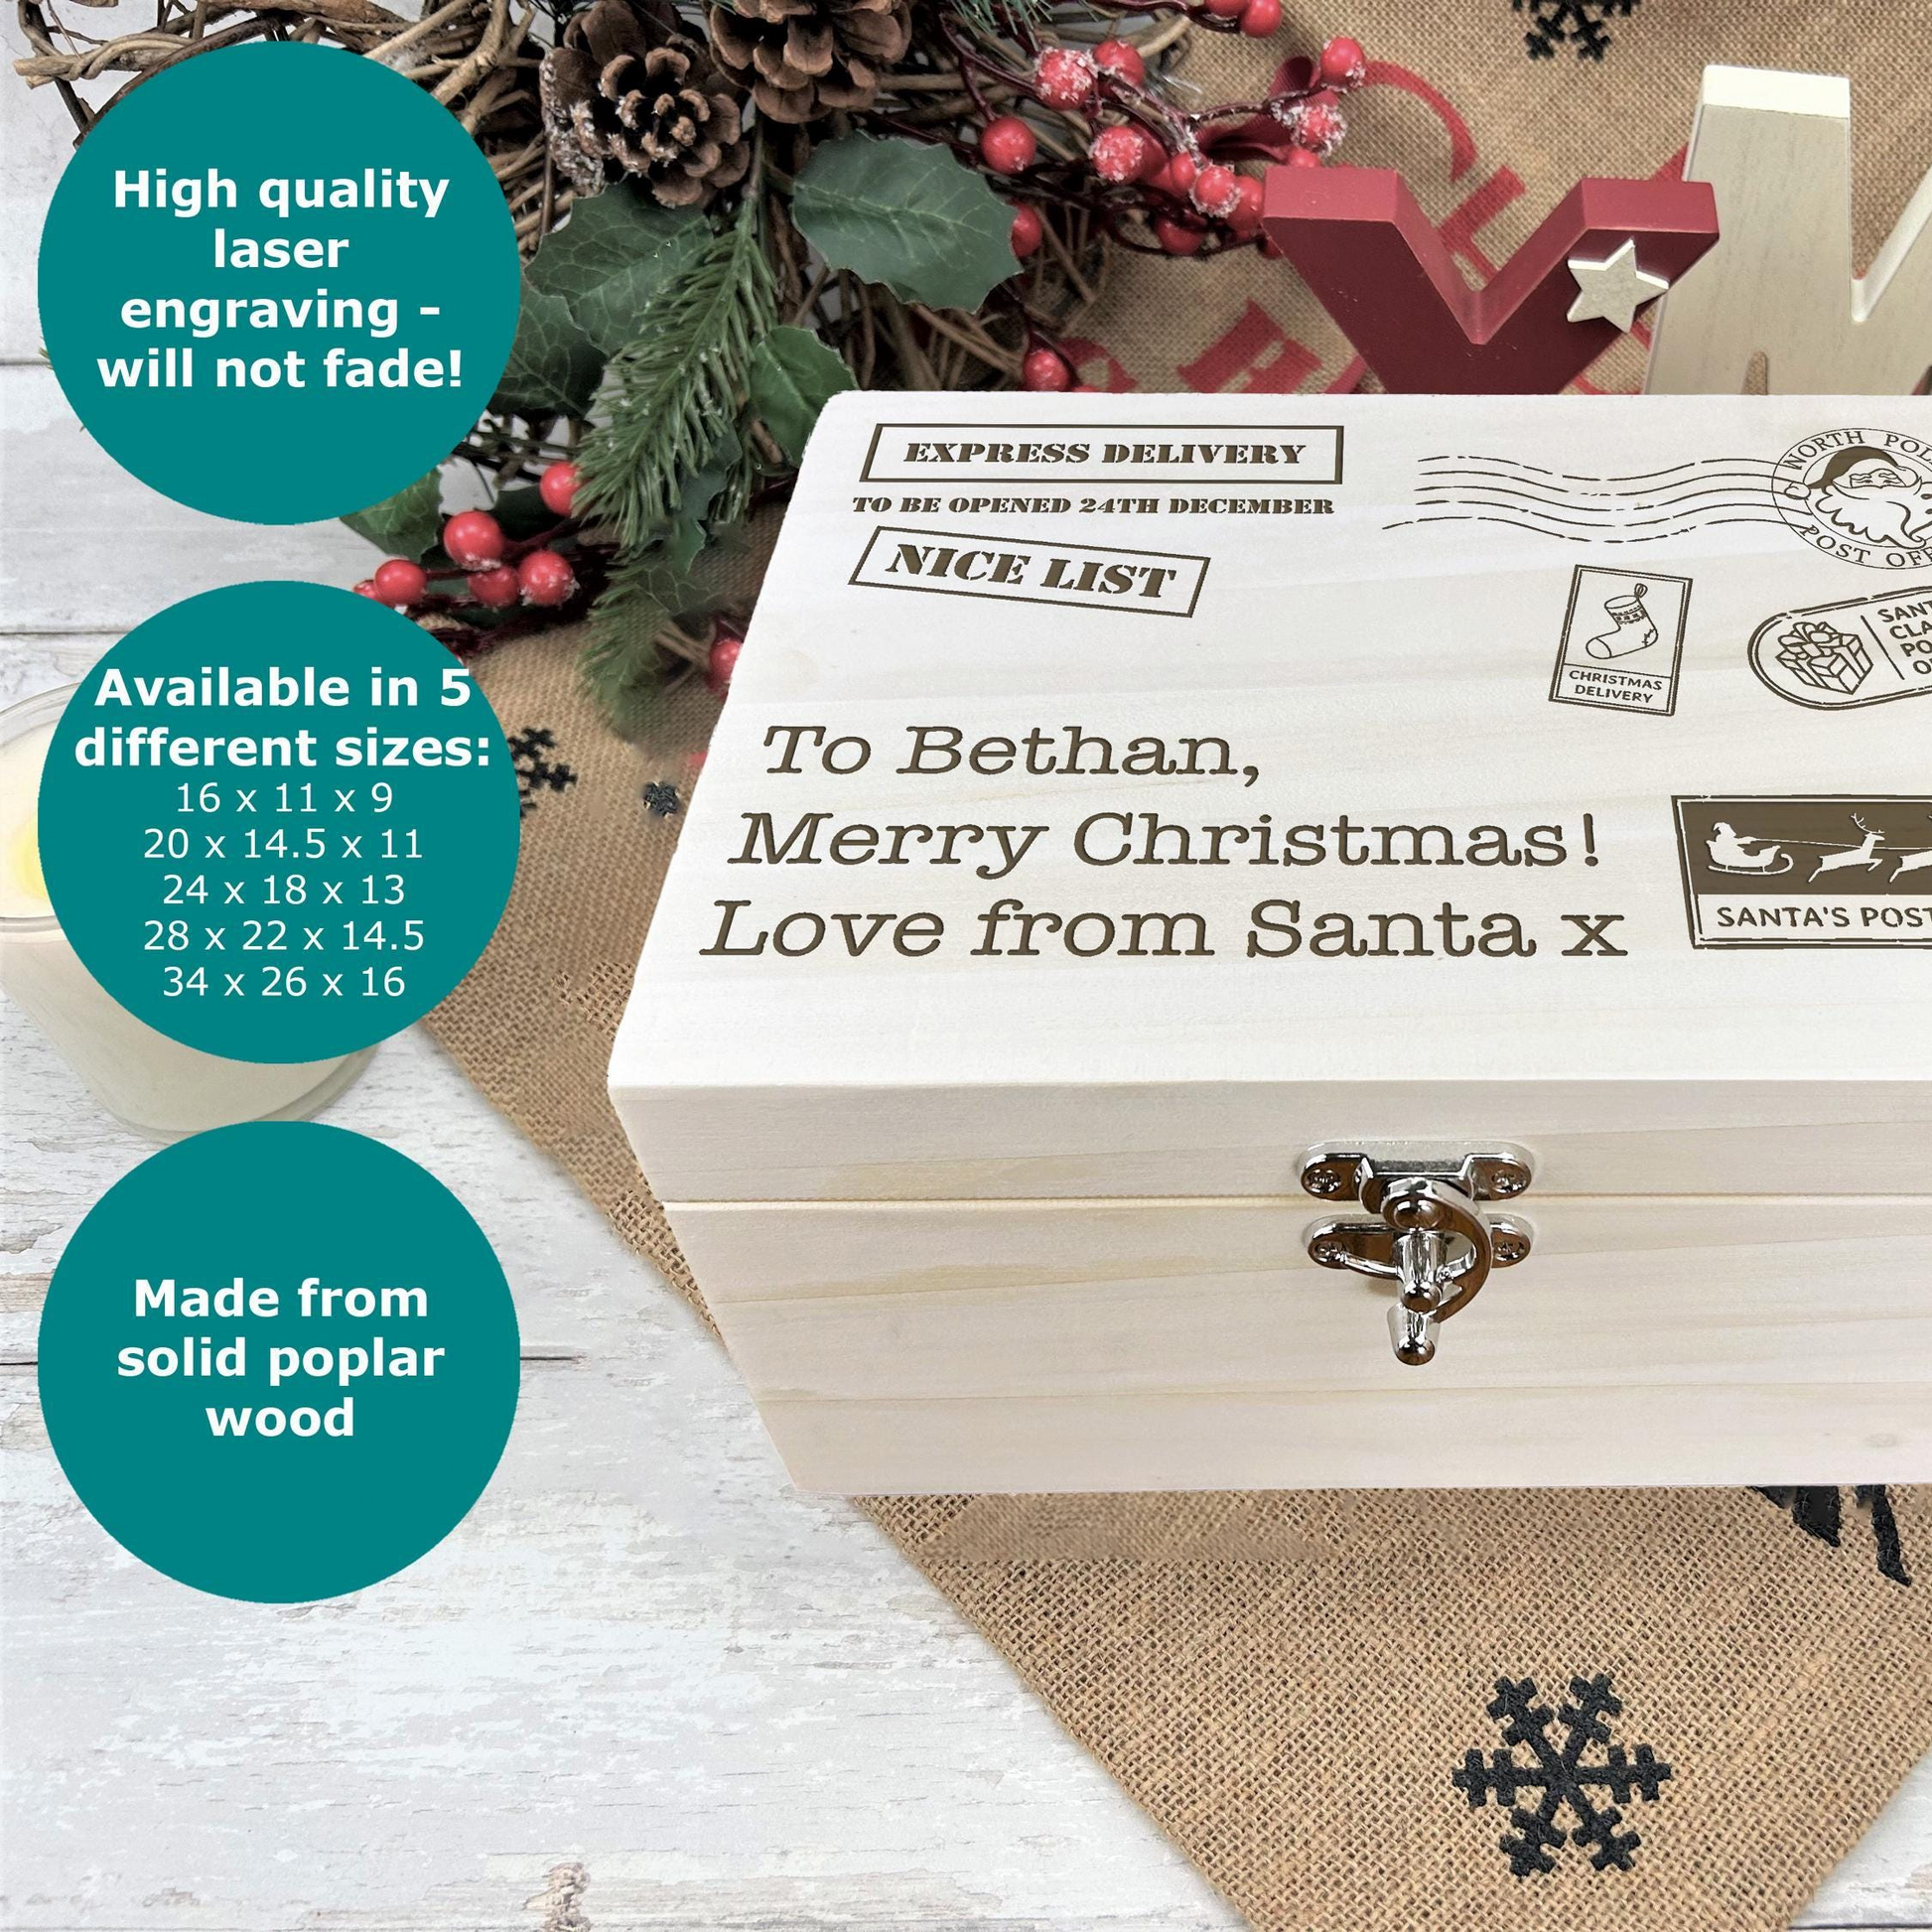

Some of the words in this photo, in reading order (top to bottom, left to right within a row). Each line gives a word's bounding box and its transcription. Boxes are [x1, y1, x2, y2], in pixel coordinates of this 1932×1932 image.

[903, 443, 1089, 464] EXPRESS
[1102, 444, 1306, 465] DELIVERY
[1783, 431, 1865, 471] NORTH
[1883, 433, 1932, 465] POL
[853, 497, 892, 512] TO
[899, 497, 941, 513] BE
[949, 497, 1072, 513] OPENED
[1079, 498, 1160, 513] 24TH
[1169, 498, 1334, 514] DECEMBER
[1799, 524, 1870, 563] POST
[886, 543, 1030, 585] NICE
[1039, 558, 1176, 599] LIST
[1569, 670, 1663, 691] CHRISTMAS
[1575, 685, 1653, 703] DELIVERY
[763, 726, 871, 775] To
[897, 726, 1259, 787] Bethan,
[727, 813, 1049, 880] Merry
[1074, 812, 1598, 867] Christmas!
[699, 900, 944, 957] Love
[971, 898, 1214, 957] from
[1247, 899, 1537, 957] Santa
[1561, 915, 1628, 956] x
[1718, 907, 1850, 927] SANTA'S
